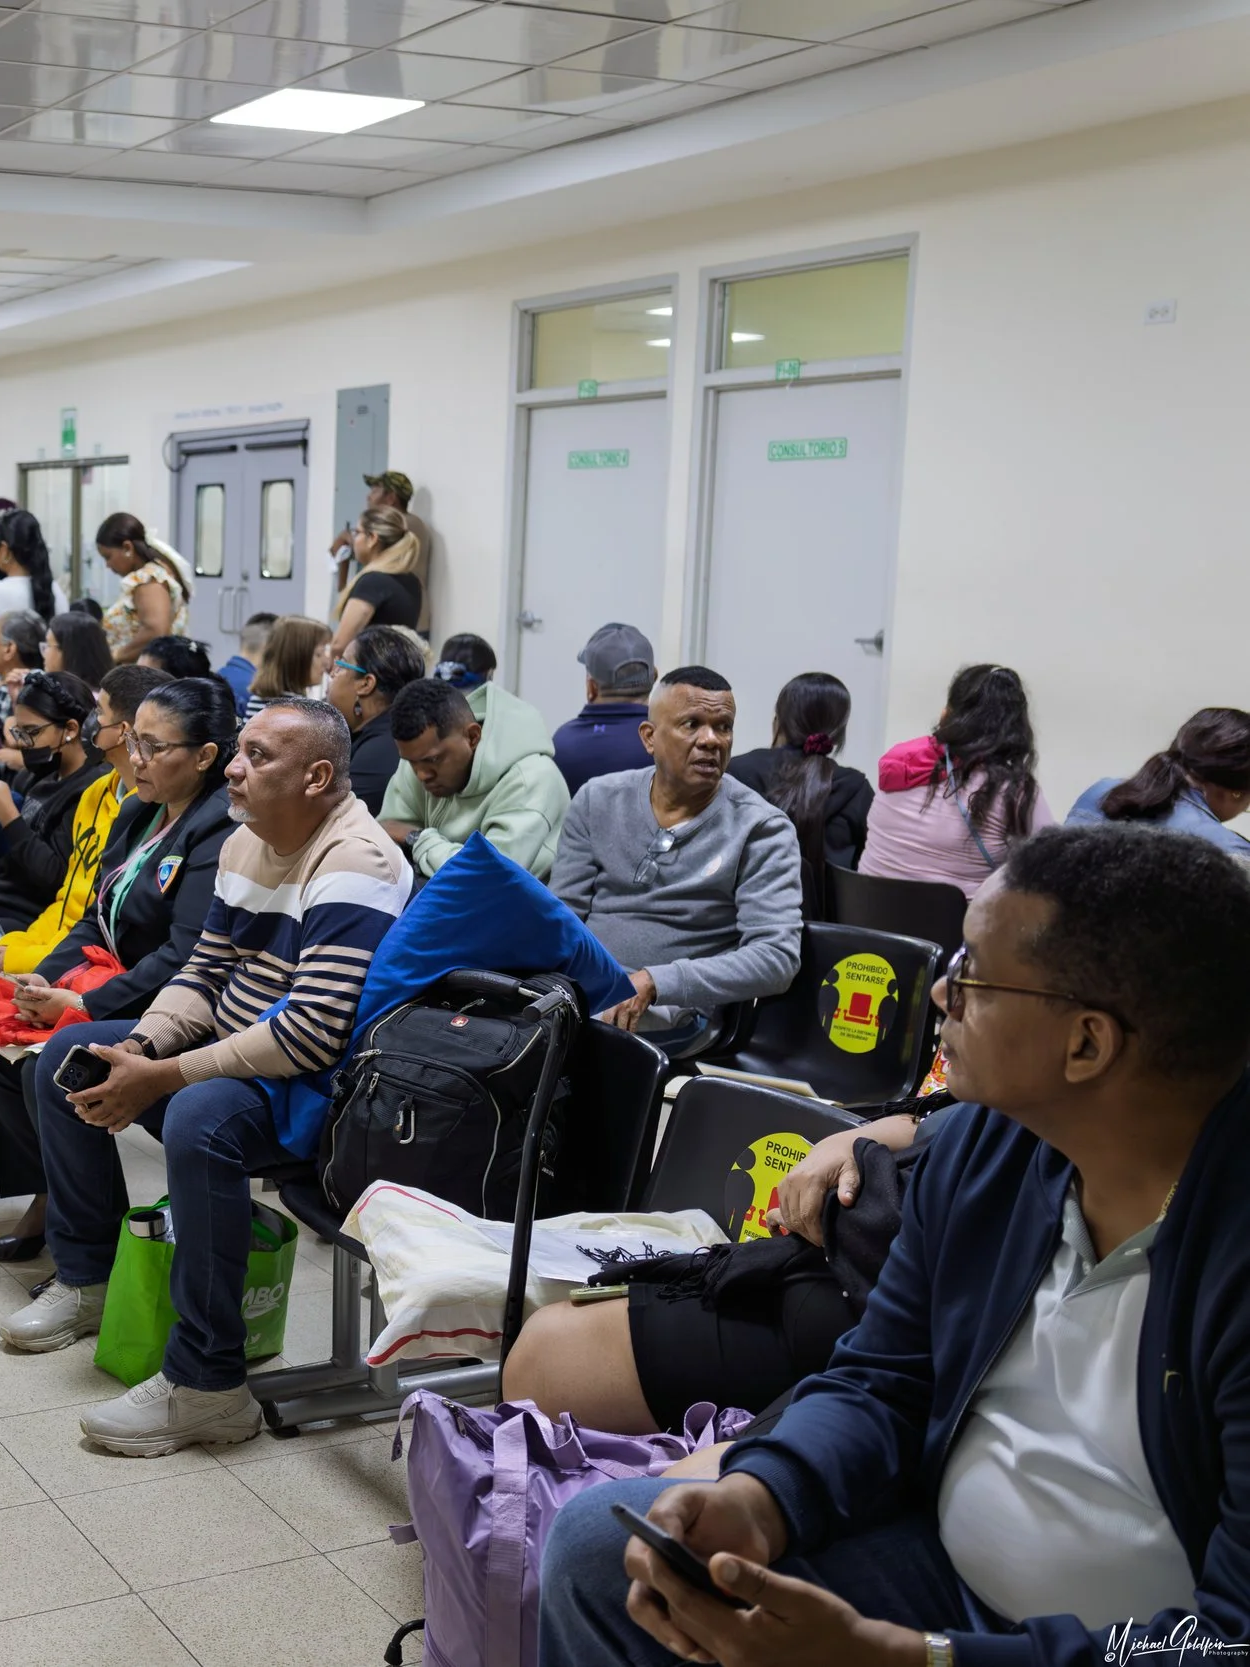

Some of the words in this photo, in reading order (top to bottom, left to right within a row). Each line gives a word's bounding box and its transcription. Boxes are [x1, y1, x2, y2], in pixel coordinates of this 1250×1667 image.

[771, 441, 837, 458] CONSULTORIO
[570, 451, 619, 467] CONSULTORIO
[846, 961, 888, 976] PROHIBIDO
[846, 972, 885, 986] SENTARSE
